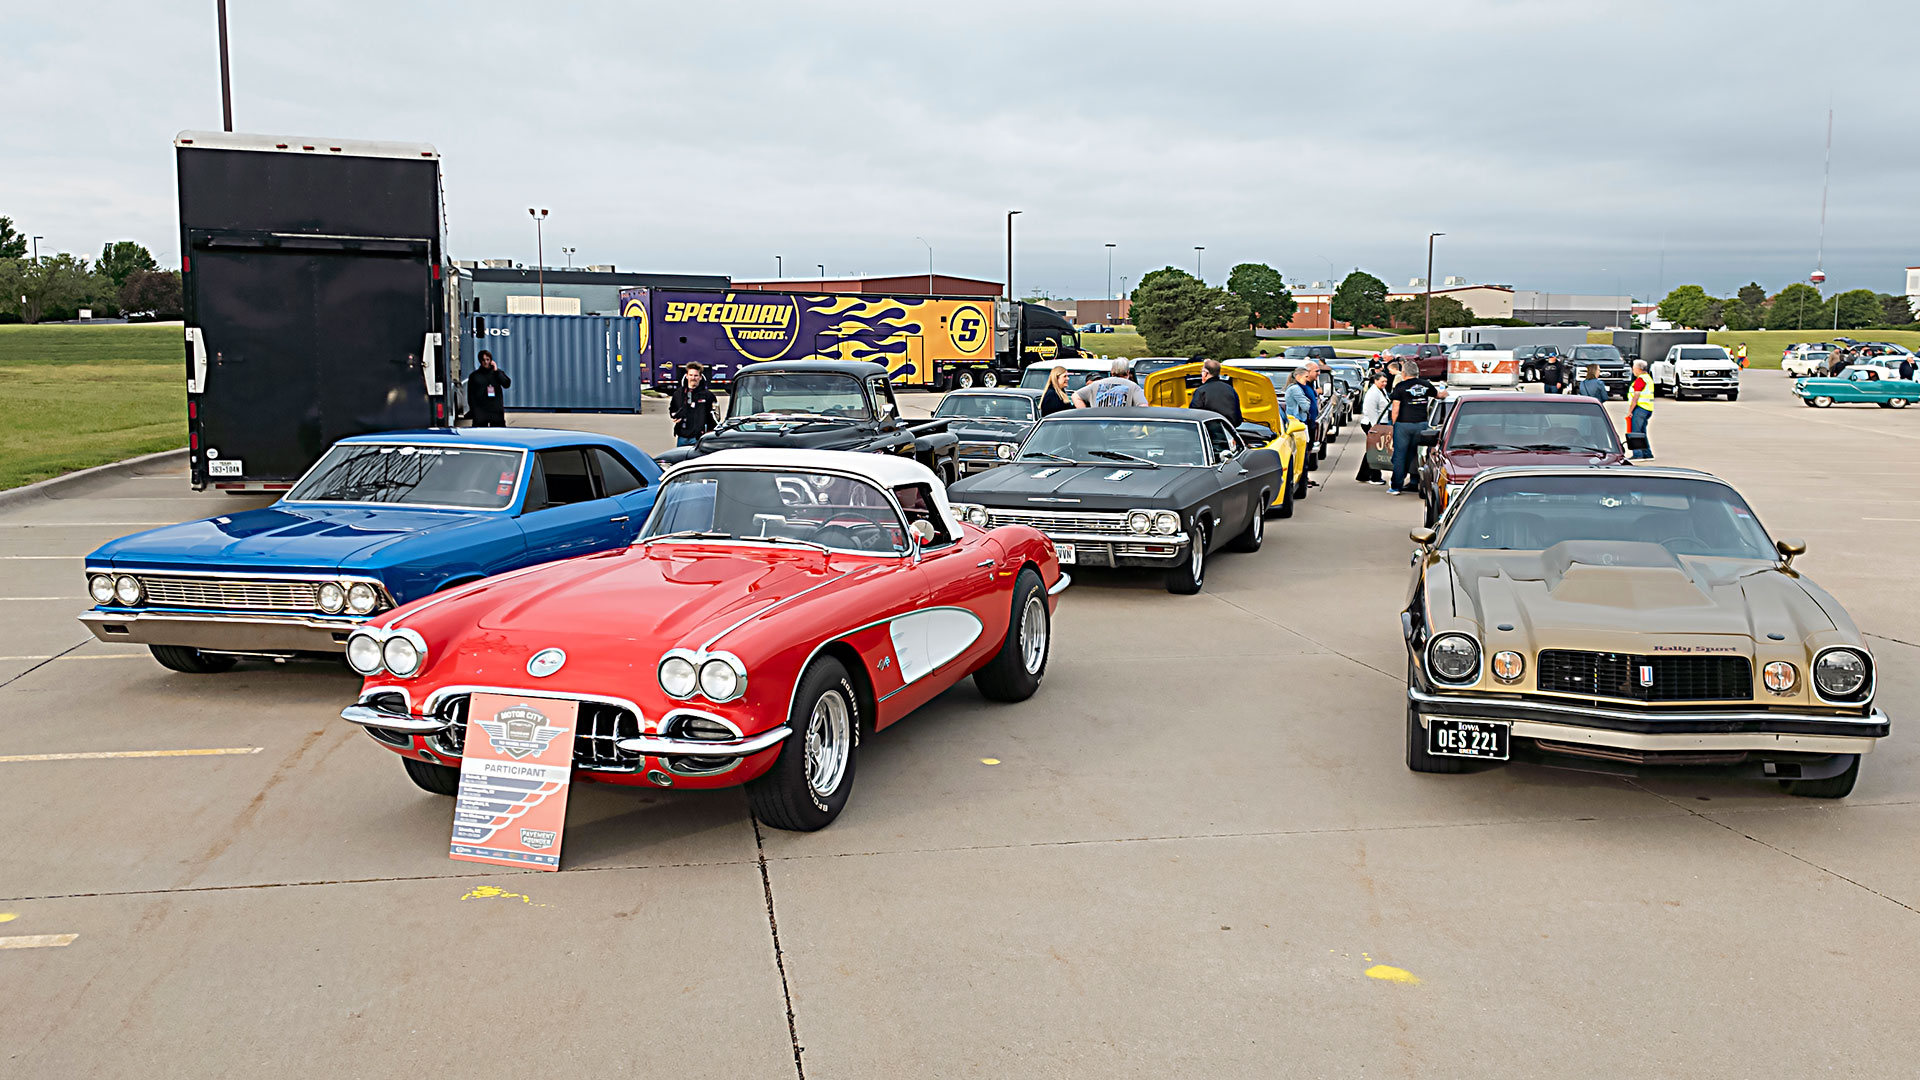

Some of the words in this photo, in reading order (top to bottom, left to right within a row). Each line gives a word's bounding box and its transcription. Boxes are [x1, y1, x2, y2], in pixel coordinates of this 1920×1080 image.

[665, 295, 793, 328] SPEEDWAY
[958, 319, 980, 341] S
[1056, 549, 1072, 559] VVN
[500, 710, 526, 720] MOTOR
[526, 711, 545, 721] CITY
[1471, 731, 1499, 750] 221
[484, 763, 548, 777] PARTICIPANT
[522, 830, 555, 839] PAVEMENT
